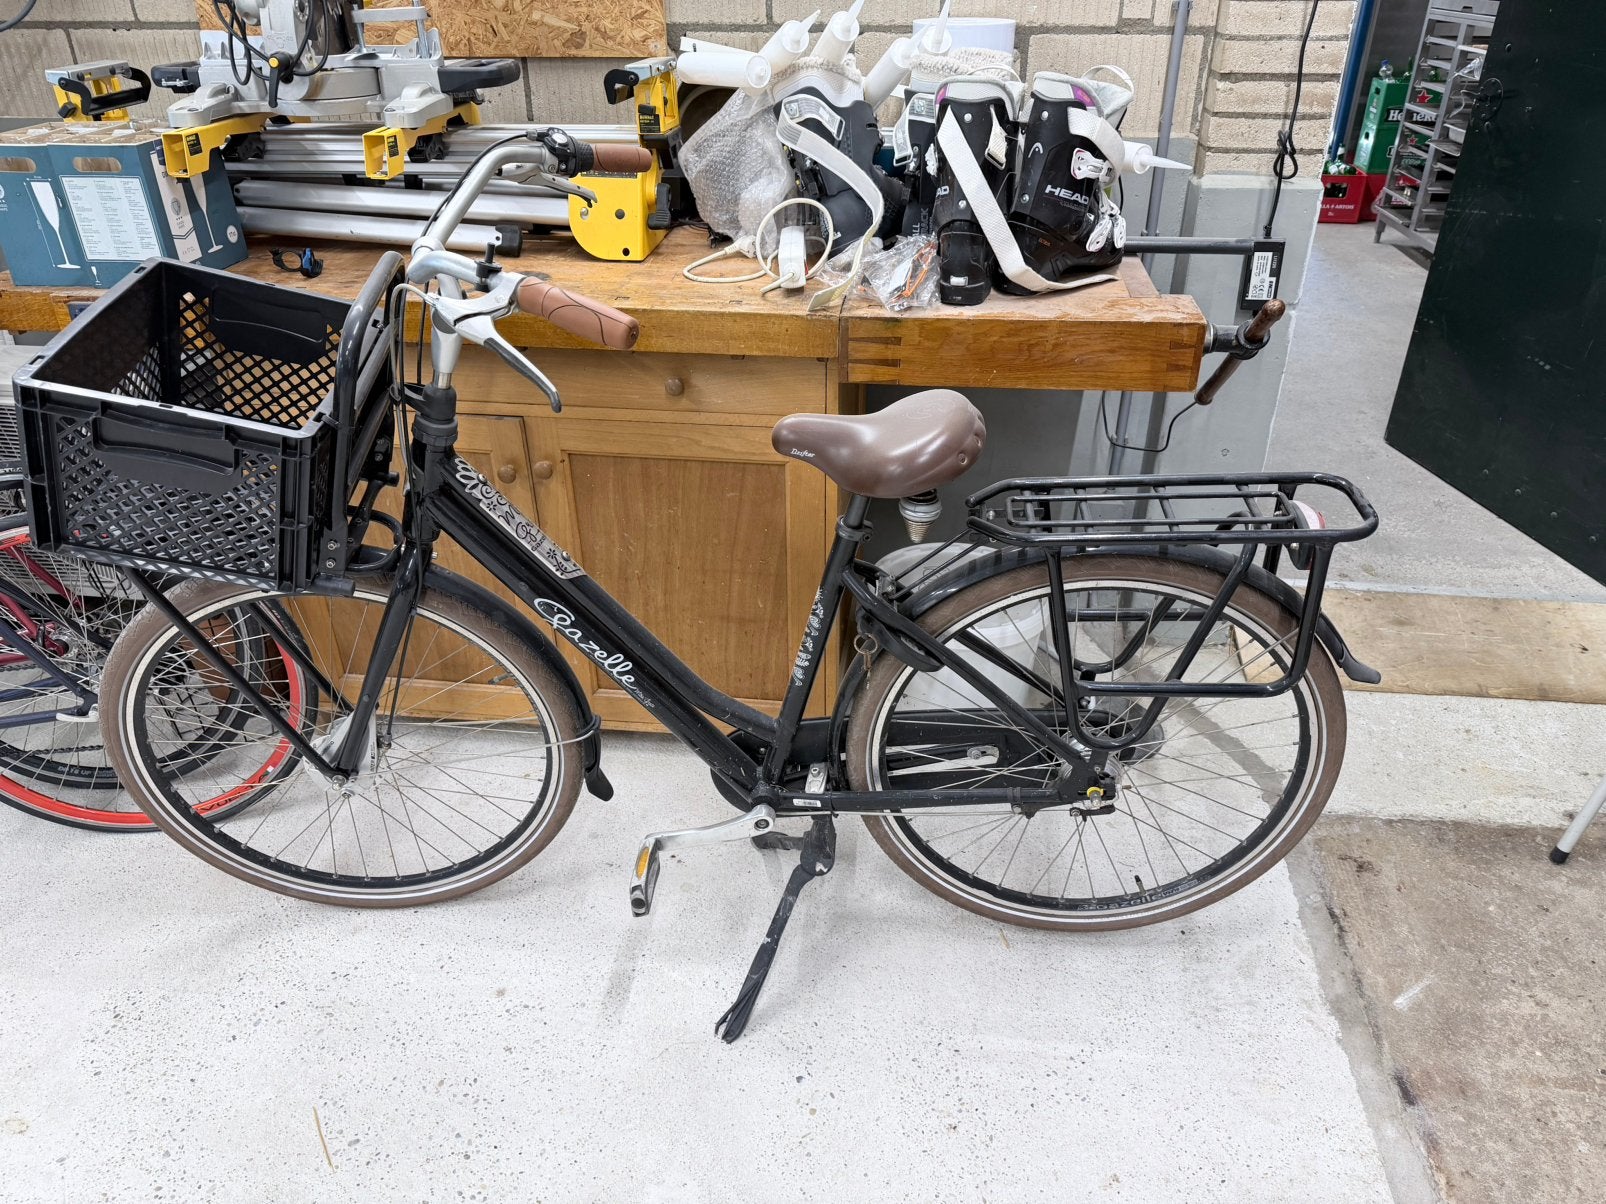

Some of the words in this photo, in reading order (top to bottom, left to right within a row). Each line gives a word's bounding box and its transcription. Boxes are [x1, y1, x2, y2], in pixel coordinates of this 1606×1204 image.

[936, 185, 950, 197] AD
[1045, 184, 1089, 204] HEAD
[533, 598, 637, 690] Gazelle
